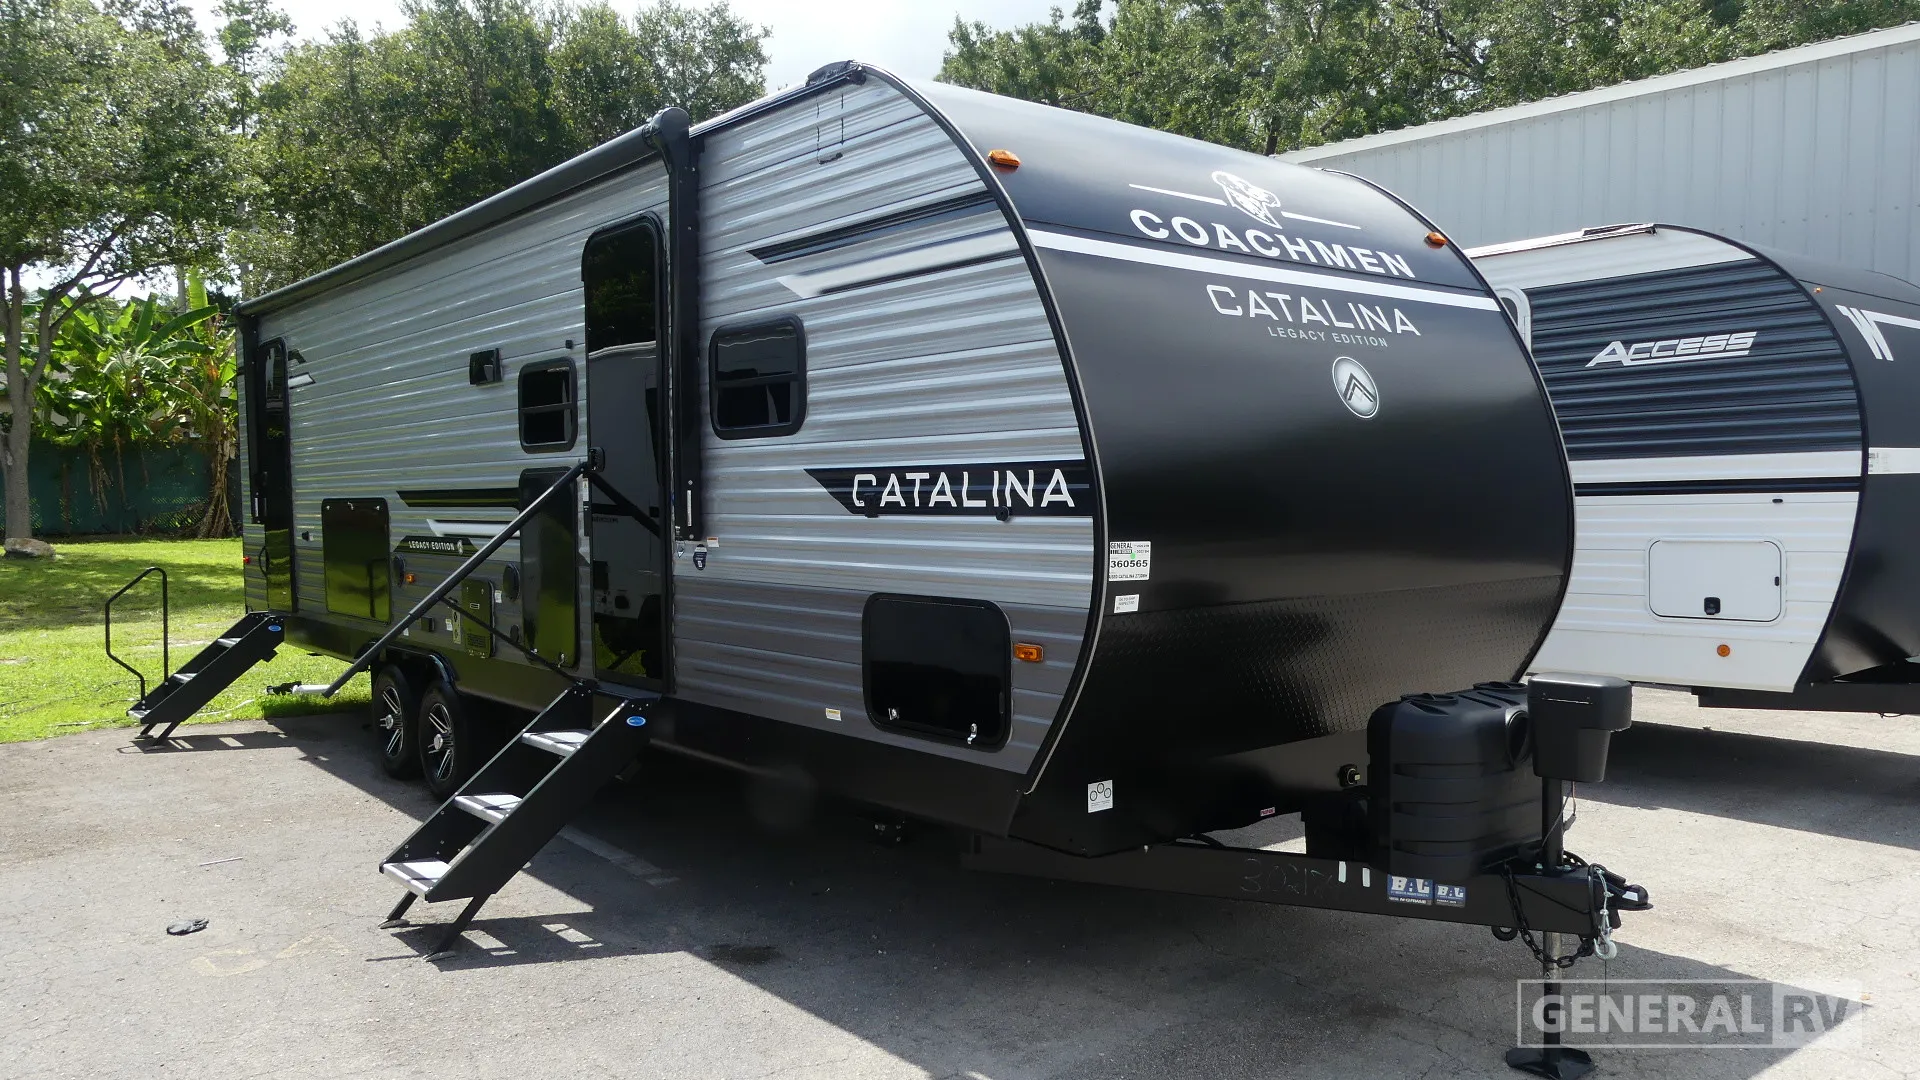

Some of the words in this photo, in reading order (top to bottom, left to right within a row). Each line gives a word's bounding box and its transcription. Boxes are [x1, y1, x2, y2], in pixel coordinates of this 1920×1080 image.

[1129, 209, 1416, 278] COACHMEN
[1206, 284, 1421, 336] CATALINA
[1267, 326, 1326, 342] LEGACY
[1332, 332, 1388, 348] EDITION
[1585, 331, 1757, 368] ACCESS
[852, 469, 1075, 508] CATALINA
[408, 541, 430, 549] LEGACY
[431, 542, 455, 551] EDITION
[1110, 559, 1148, 569] 360565
